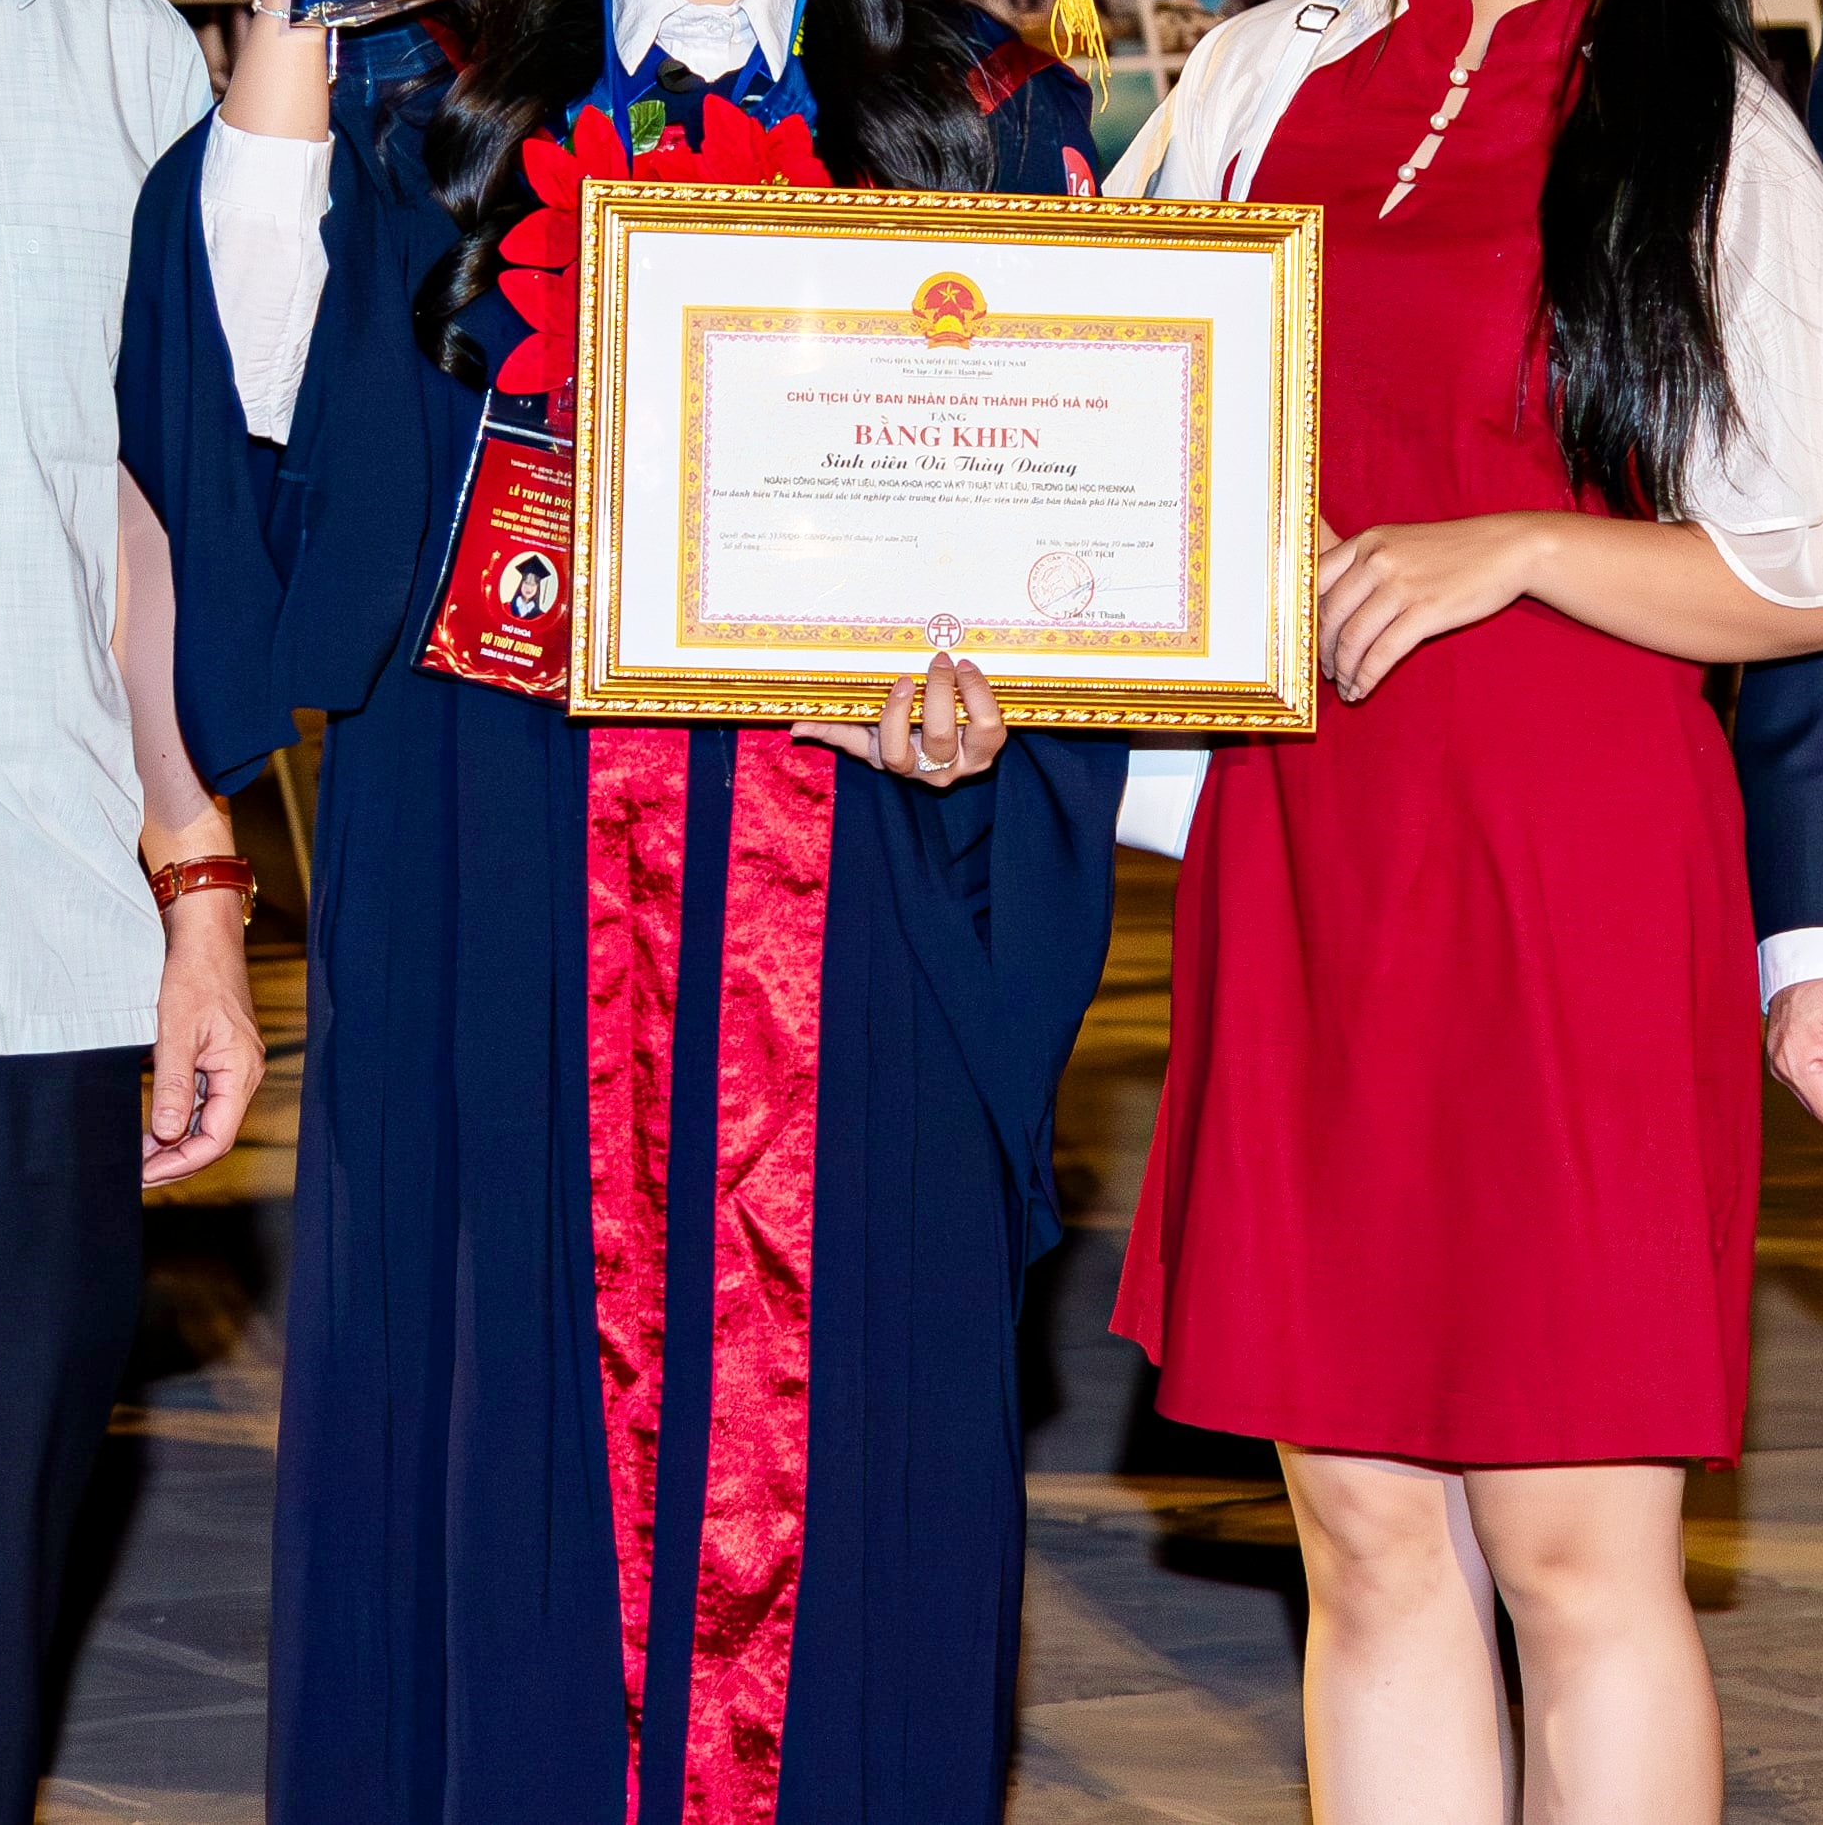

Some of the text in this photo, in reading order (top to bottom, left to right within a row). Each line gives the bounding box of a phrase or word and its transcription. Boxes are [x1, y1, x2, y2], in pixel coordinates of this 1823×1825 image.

[787, 387, 1108, 412] CHỦ TỊCH ỦY BAN NHÂN DÂN THÀNH PHỐ HÀ NỘI
[855, 415, 1041, 448] BẰNG KHEN
[821, 452, 865, 469] Sinh
[871, 454, 909, 470] viên
[953, 455, 1004, 474] Thùy
[1011, 457, 1078, 477] Dương
[522, 488, 552, 504] TUYÊN
[1158, 499, 1178, 508] 2024
